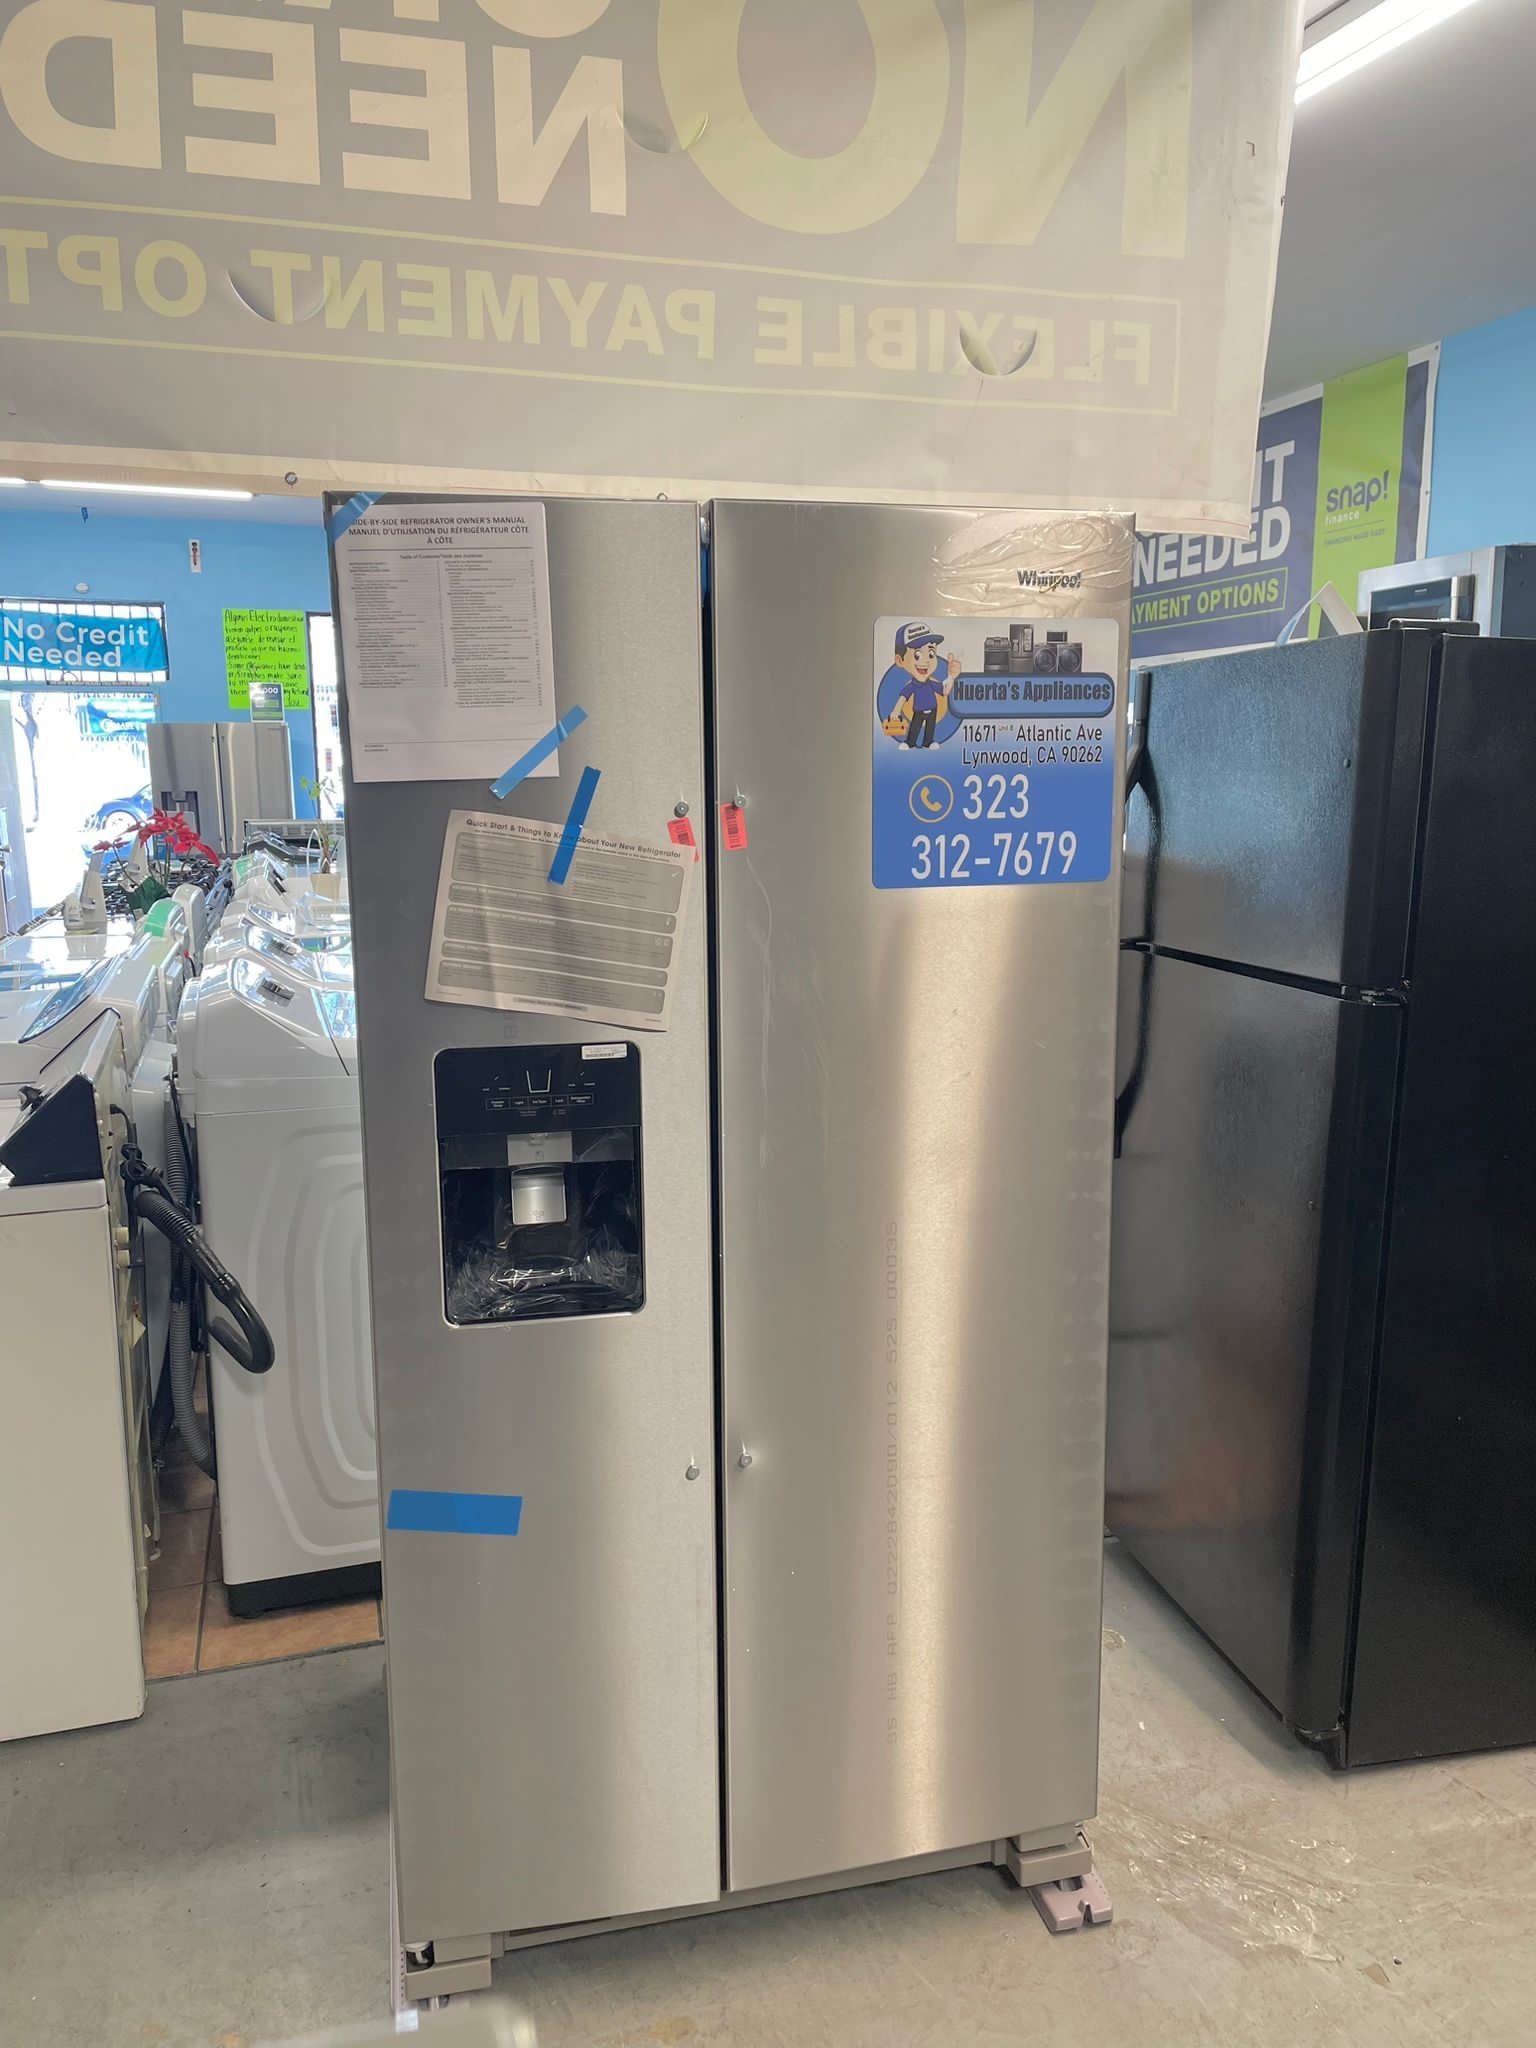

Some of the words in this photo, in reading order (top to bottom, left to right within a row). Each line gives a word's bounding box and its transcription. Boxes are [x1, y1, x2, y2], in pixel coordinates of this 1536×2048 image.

[1326, 470, 1389, 512] snap!
[348, 528, 381, 536] MANUEL
[437, 527, 449, 535] DU
[400, 517, 455, 526] REFRIGERATOR
[492, 516, 525, 524] MANUAL
[1197, 578, 1279, 614] OPTIONS
[3, 616, 46, 640] No
[56, 621, 149, 647] Credit
[4, 639, 122, 668] Needed
[954, 681, 1019, 701] Huerta's
[1023, 680, 1111, 702] Appliances
[963, 725, 996, 743] 11671
[1016, 724, 1071, 742] Atlantic
[1076, 724, 1102, 742] Ave
[963, 749, 1032, 768] Lynwood,
[1037, 747, 1056, 764] CA
[1062, 746, 1102, 763] 90262
[962, 774, 1029, 820] 323
[466, 818, 488, 828] Quick
[490, 821, 507, 831] Start
[518, 825, 541, 836] Things
[600, 839, 617, 848] Your
[619, 843, 635, 851] New
[637, 846, 681, 858] Refrigerator
[911, 831, 1077, 880] 312-7679
